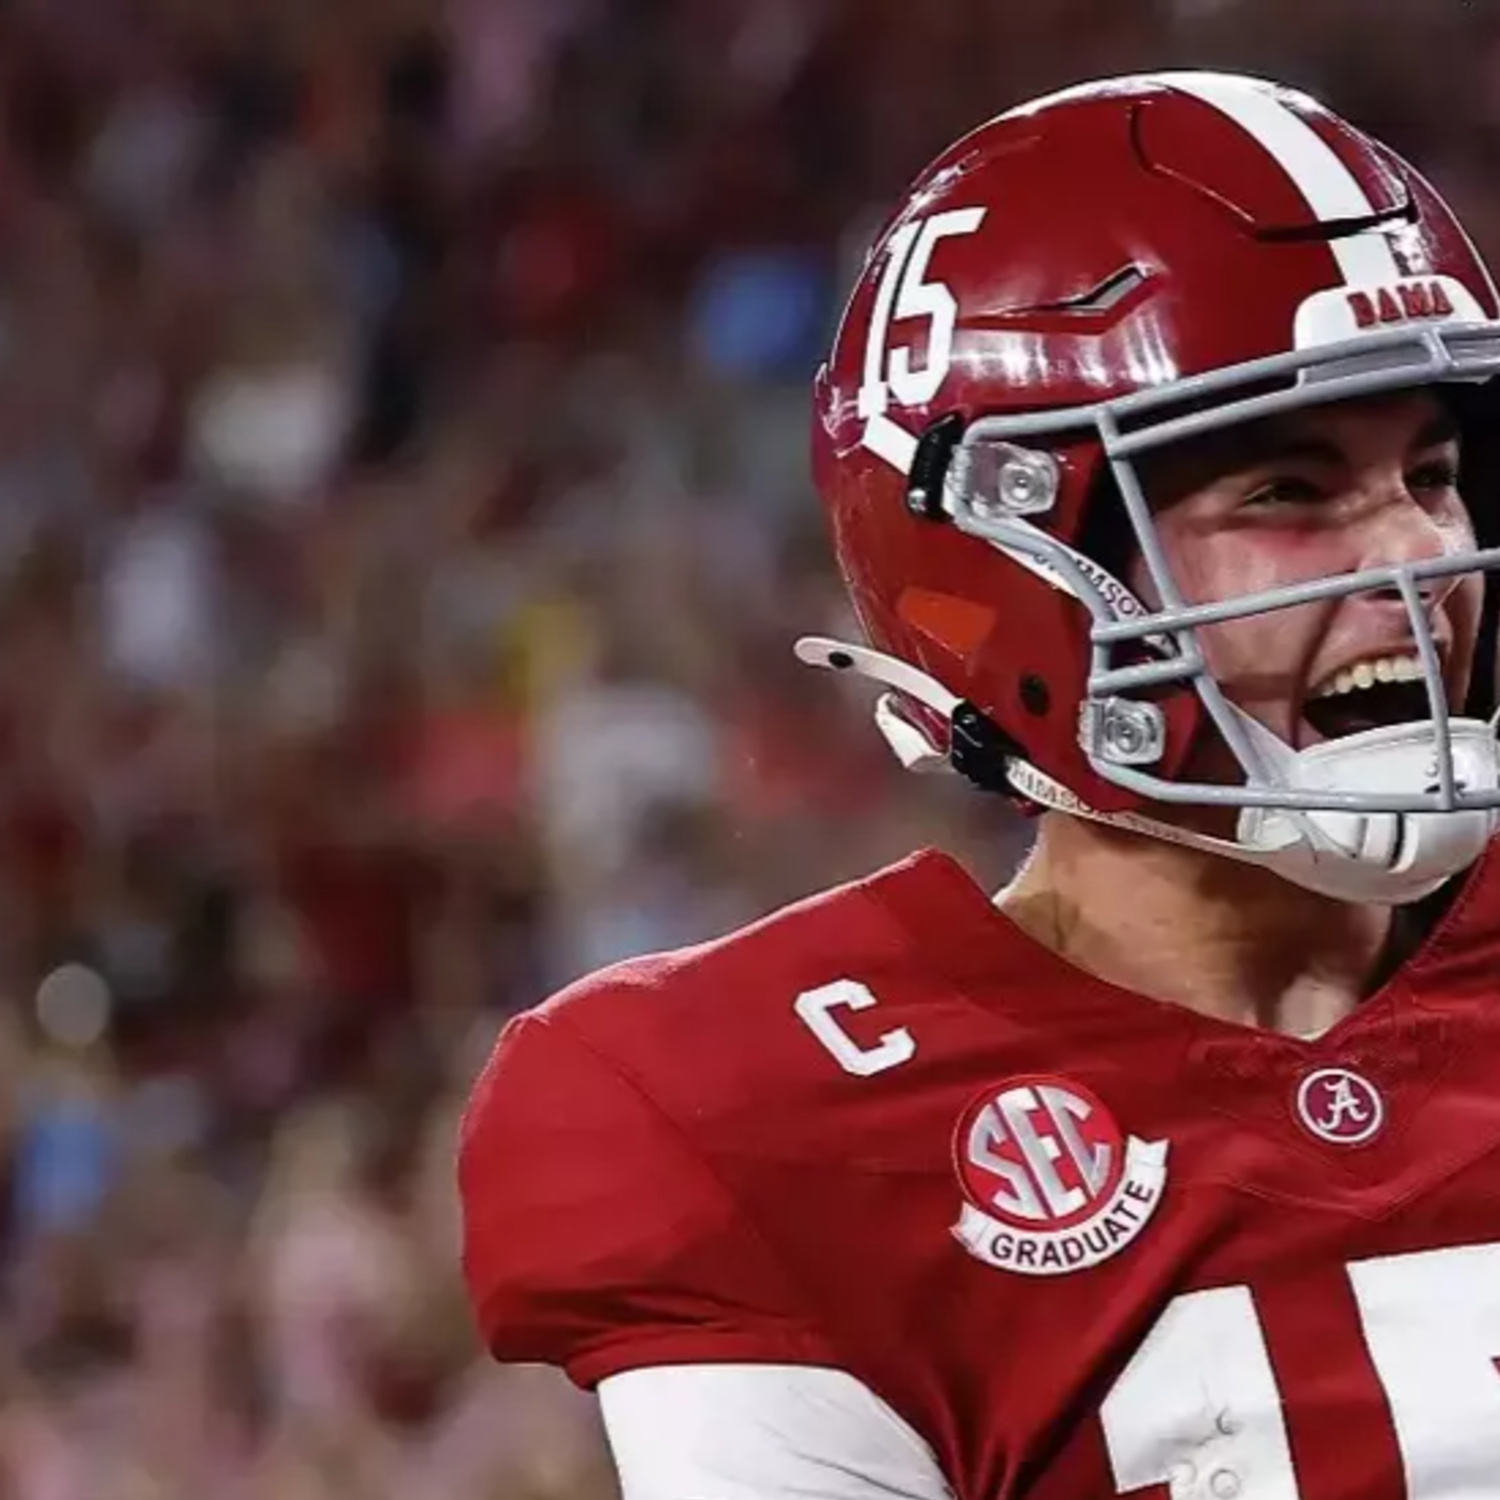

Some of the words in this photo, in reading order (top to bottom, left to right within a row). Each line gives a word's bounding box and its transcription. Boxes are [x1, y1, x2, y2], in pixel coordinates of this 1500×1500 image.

[857, 206, 988, 419] 15
[1346, 281, 1455, 329] BAMA
[793, 978, 917, 1077] C
[1316, 1073, 1369, 1131] A
[967, 1085, 1112, 1221] SEC
[990, 1180, 1155, 1268] GRADUATE
